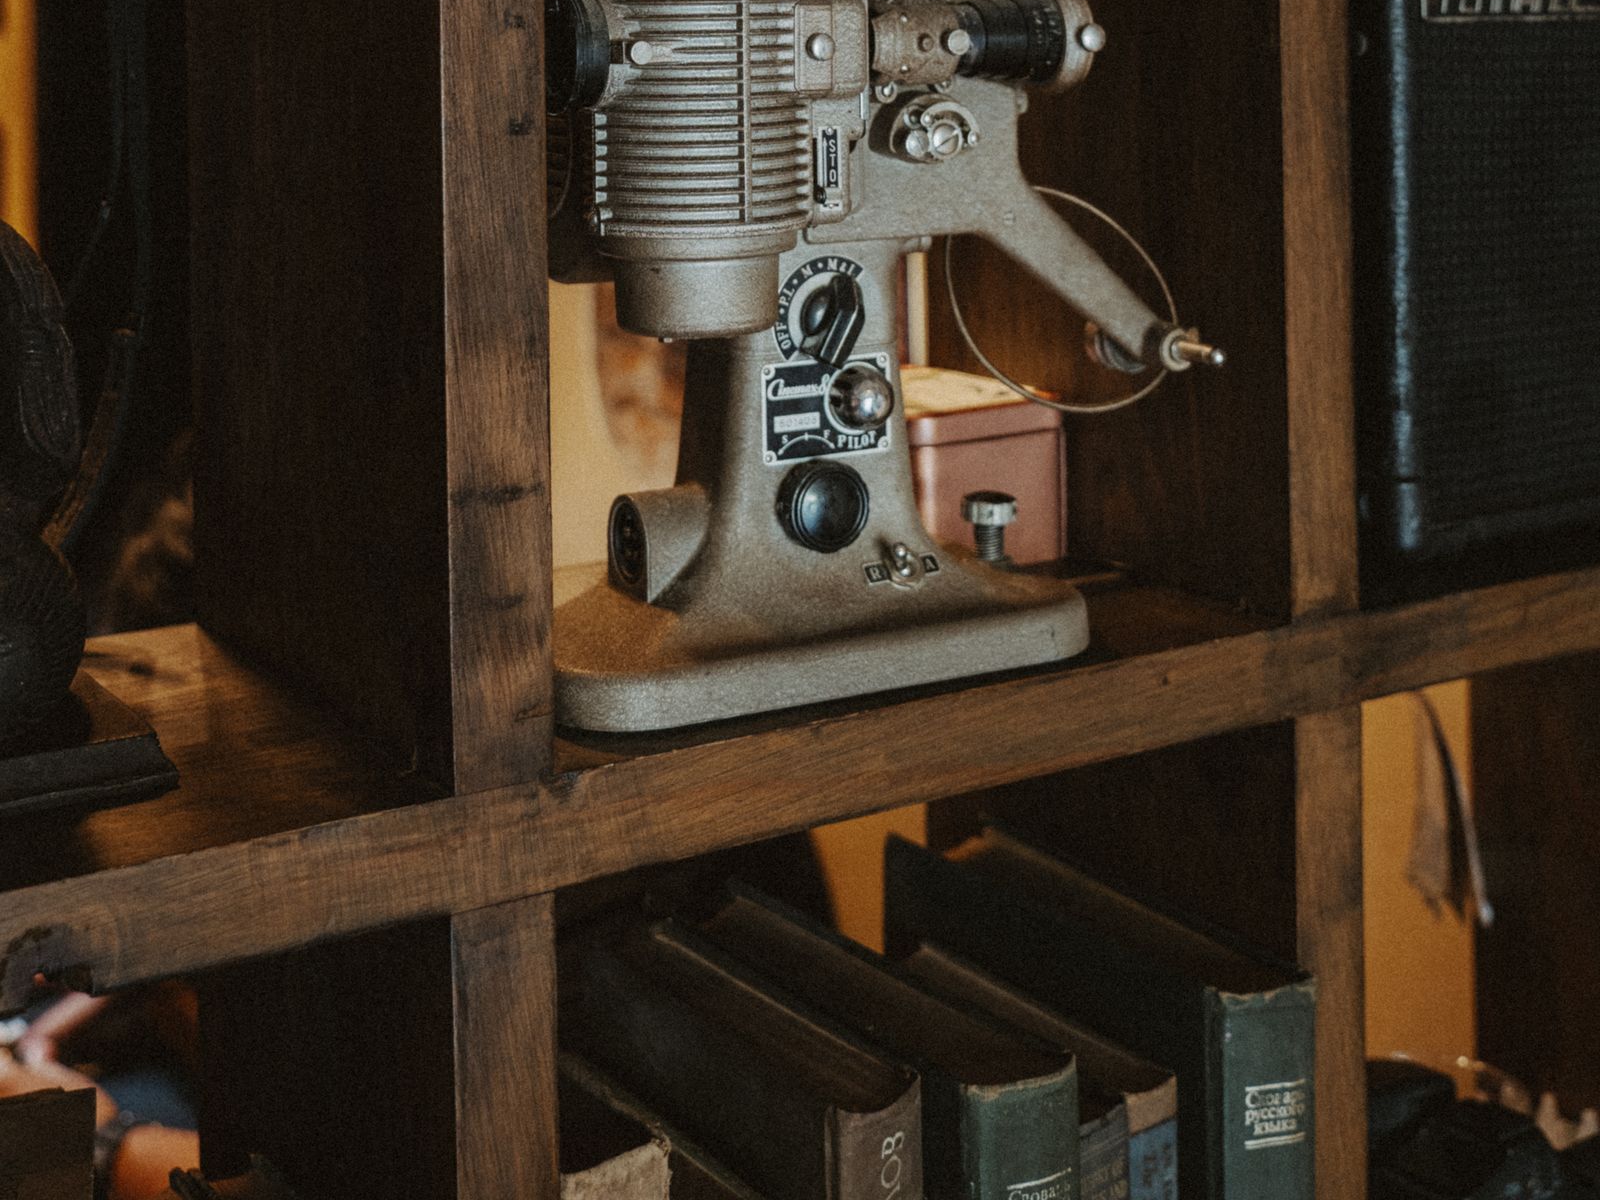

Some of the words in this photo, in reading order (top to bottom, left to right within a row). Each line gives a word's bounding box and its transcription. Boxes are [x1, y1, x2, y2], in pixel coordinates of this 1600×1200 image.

[828, 139, 837, 188] STO
[775, 321, 792, 350] OFF
[781, 434, 789, 443] S
[837, 430, 877, 449] PILOT
[925, 558, 936, 570] A
[869, 567, 881, 580] R
[1253, 1119, 1298, 1136] языка
